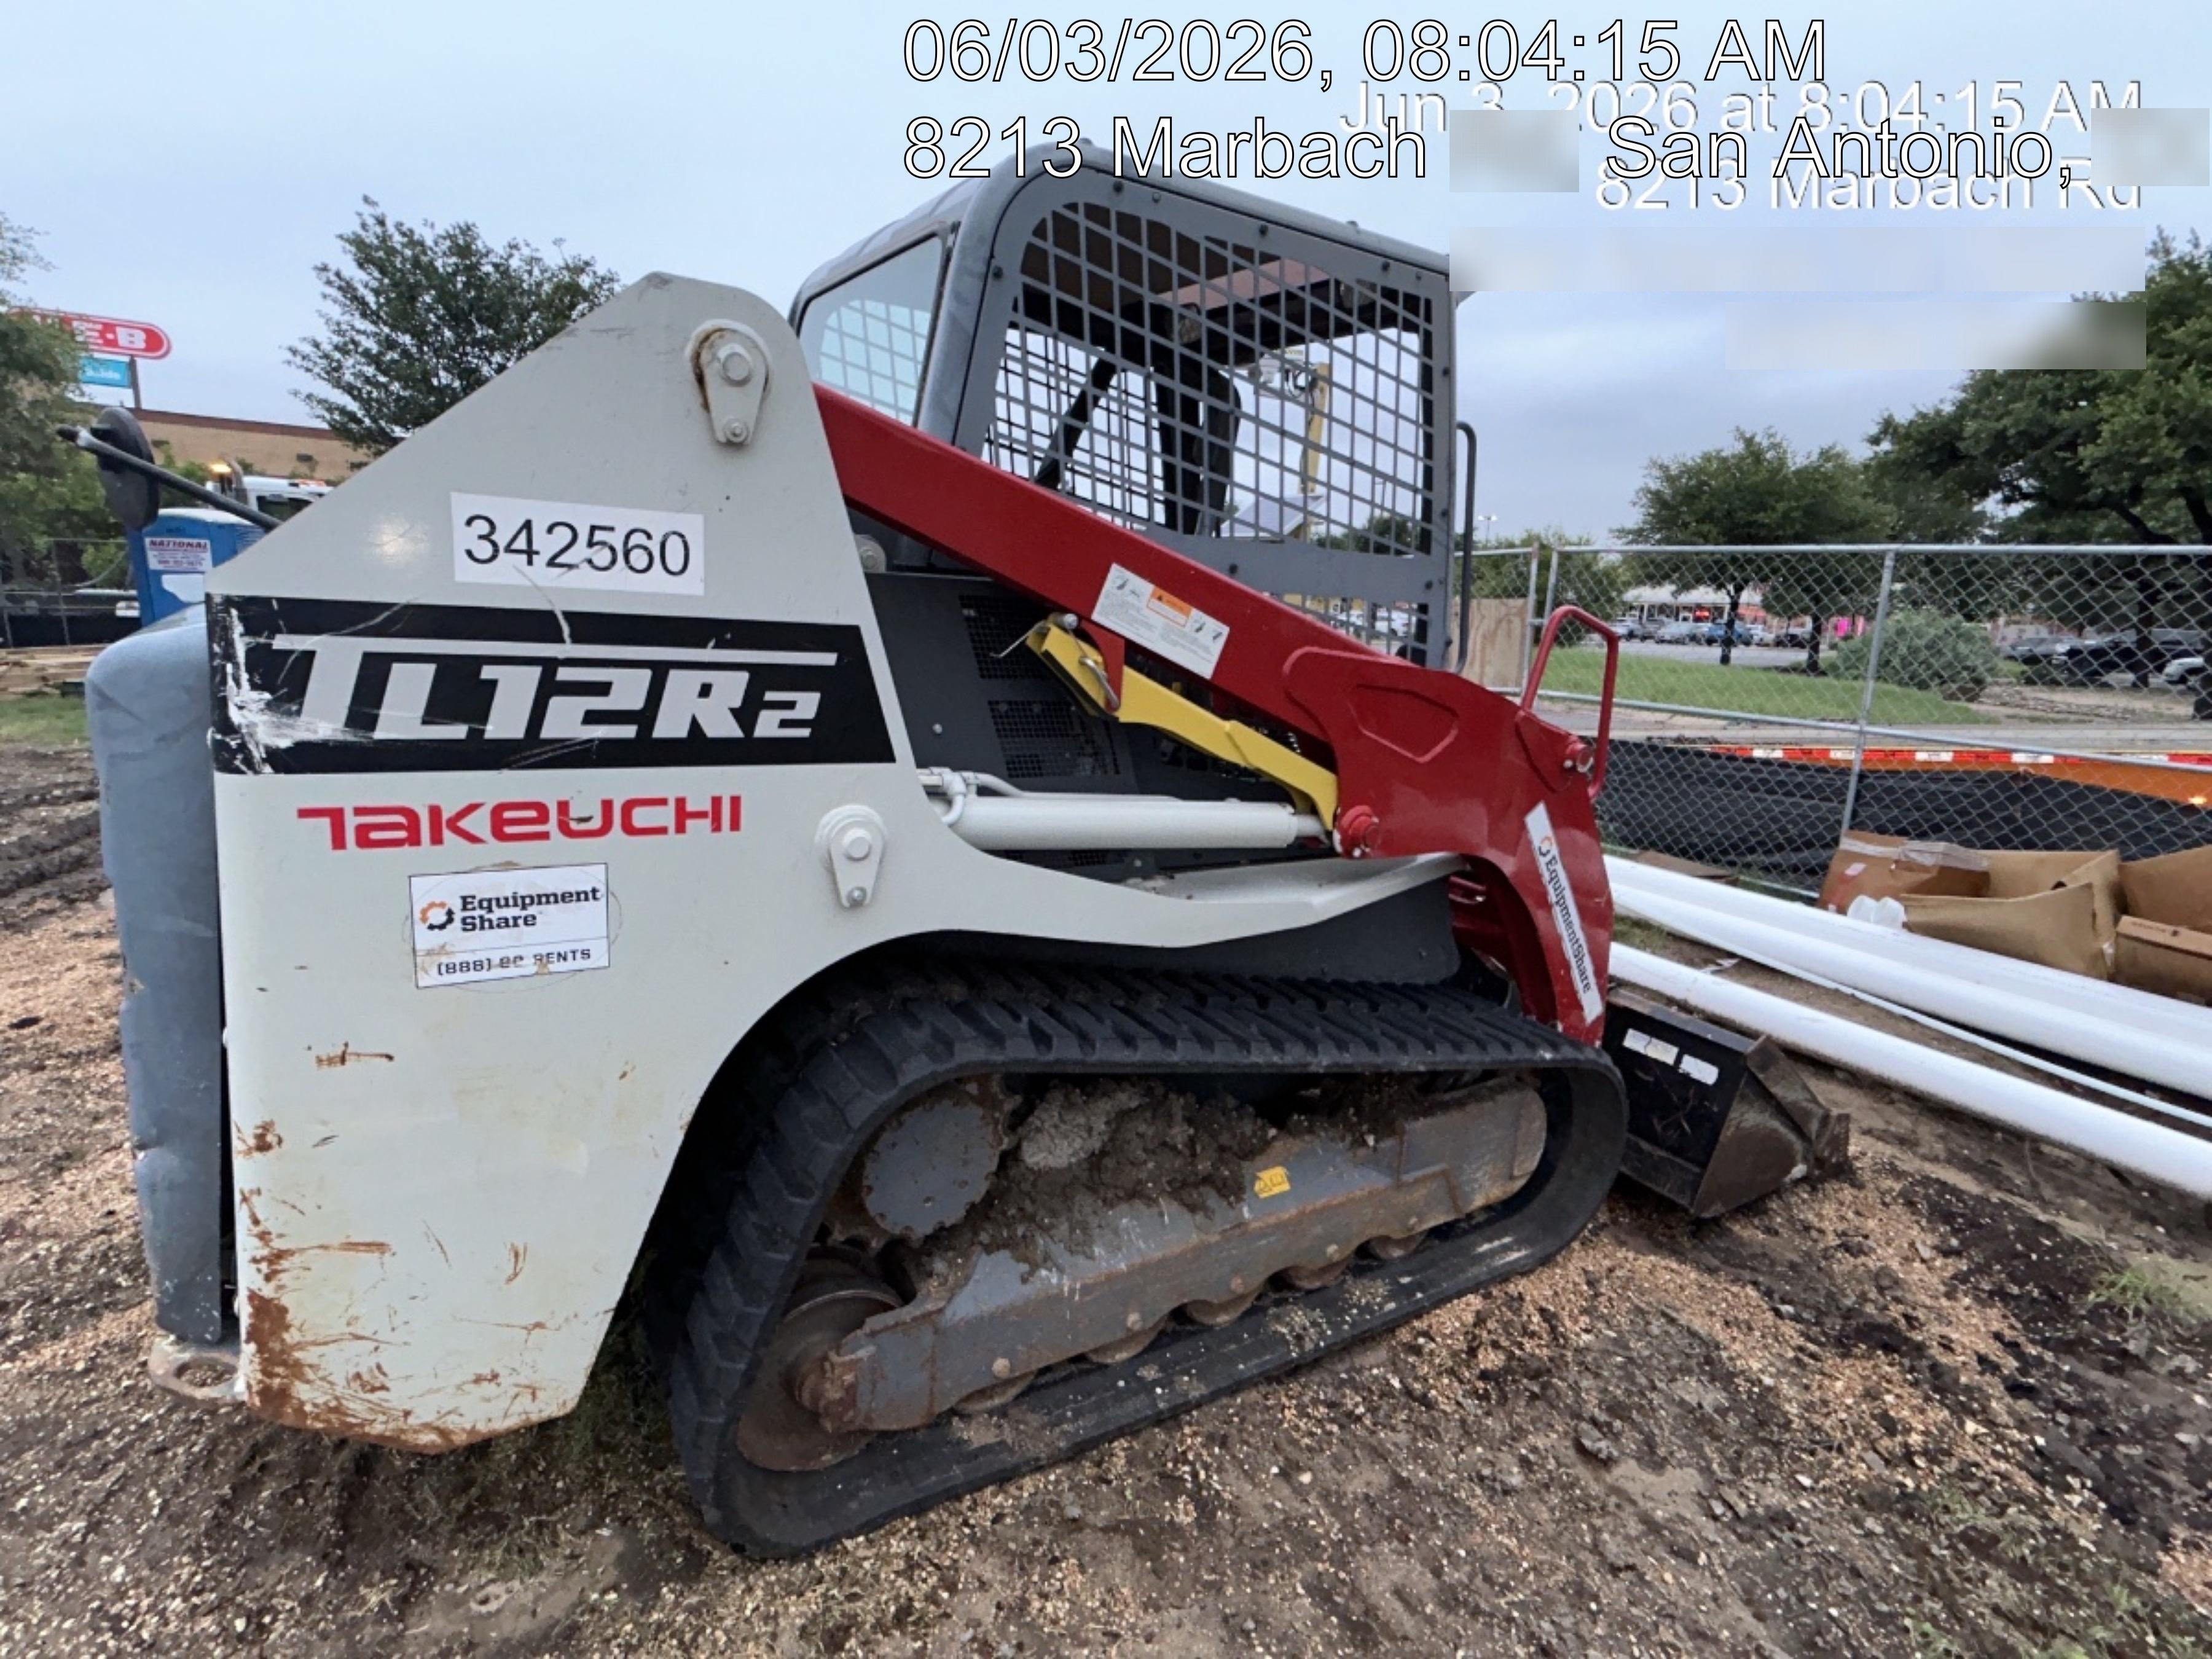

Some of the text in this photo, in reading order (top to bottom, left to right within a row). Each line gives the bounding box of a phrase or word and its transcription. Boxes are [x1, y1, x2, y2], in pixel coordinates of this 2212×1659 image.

[464, 514, 690, 576] 342560
[273, 633, 837, 740] TL12R2
[460, 887, 602, 914] Equipment
[461, 913, 537, 932] Share
[1544, 855, 1592, 994] EquipmentShare
[437, 959, 492, 976] (888)
